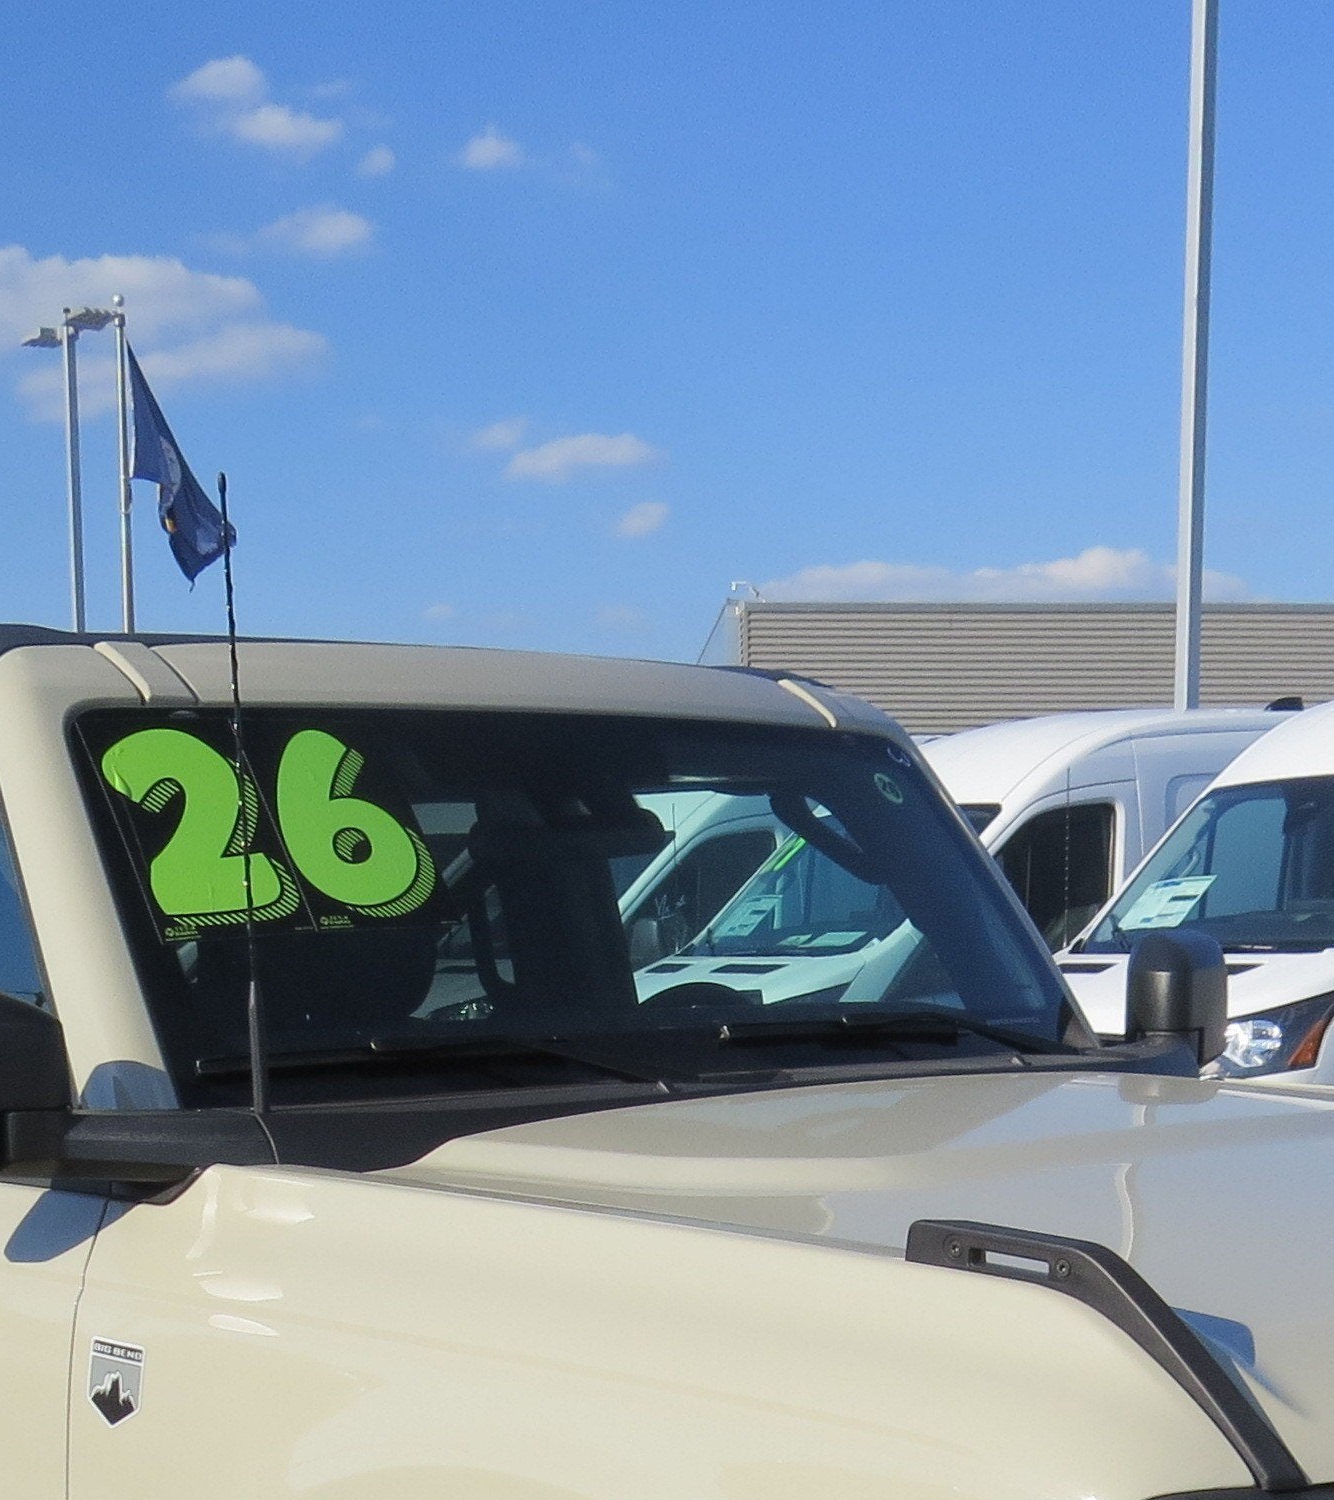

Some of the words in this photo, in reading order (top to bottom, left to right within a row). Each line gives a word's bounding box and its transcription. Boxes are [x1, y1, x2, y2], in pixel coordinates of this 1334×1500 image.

[101, 727, 436, 928] 26
[94, 1343, 112, 1354] BIG
[113, 1347, 143, 1360] BEND
